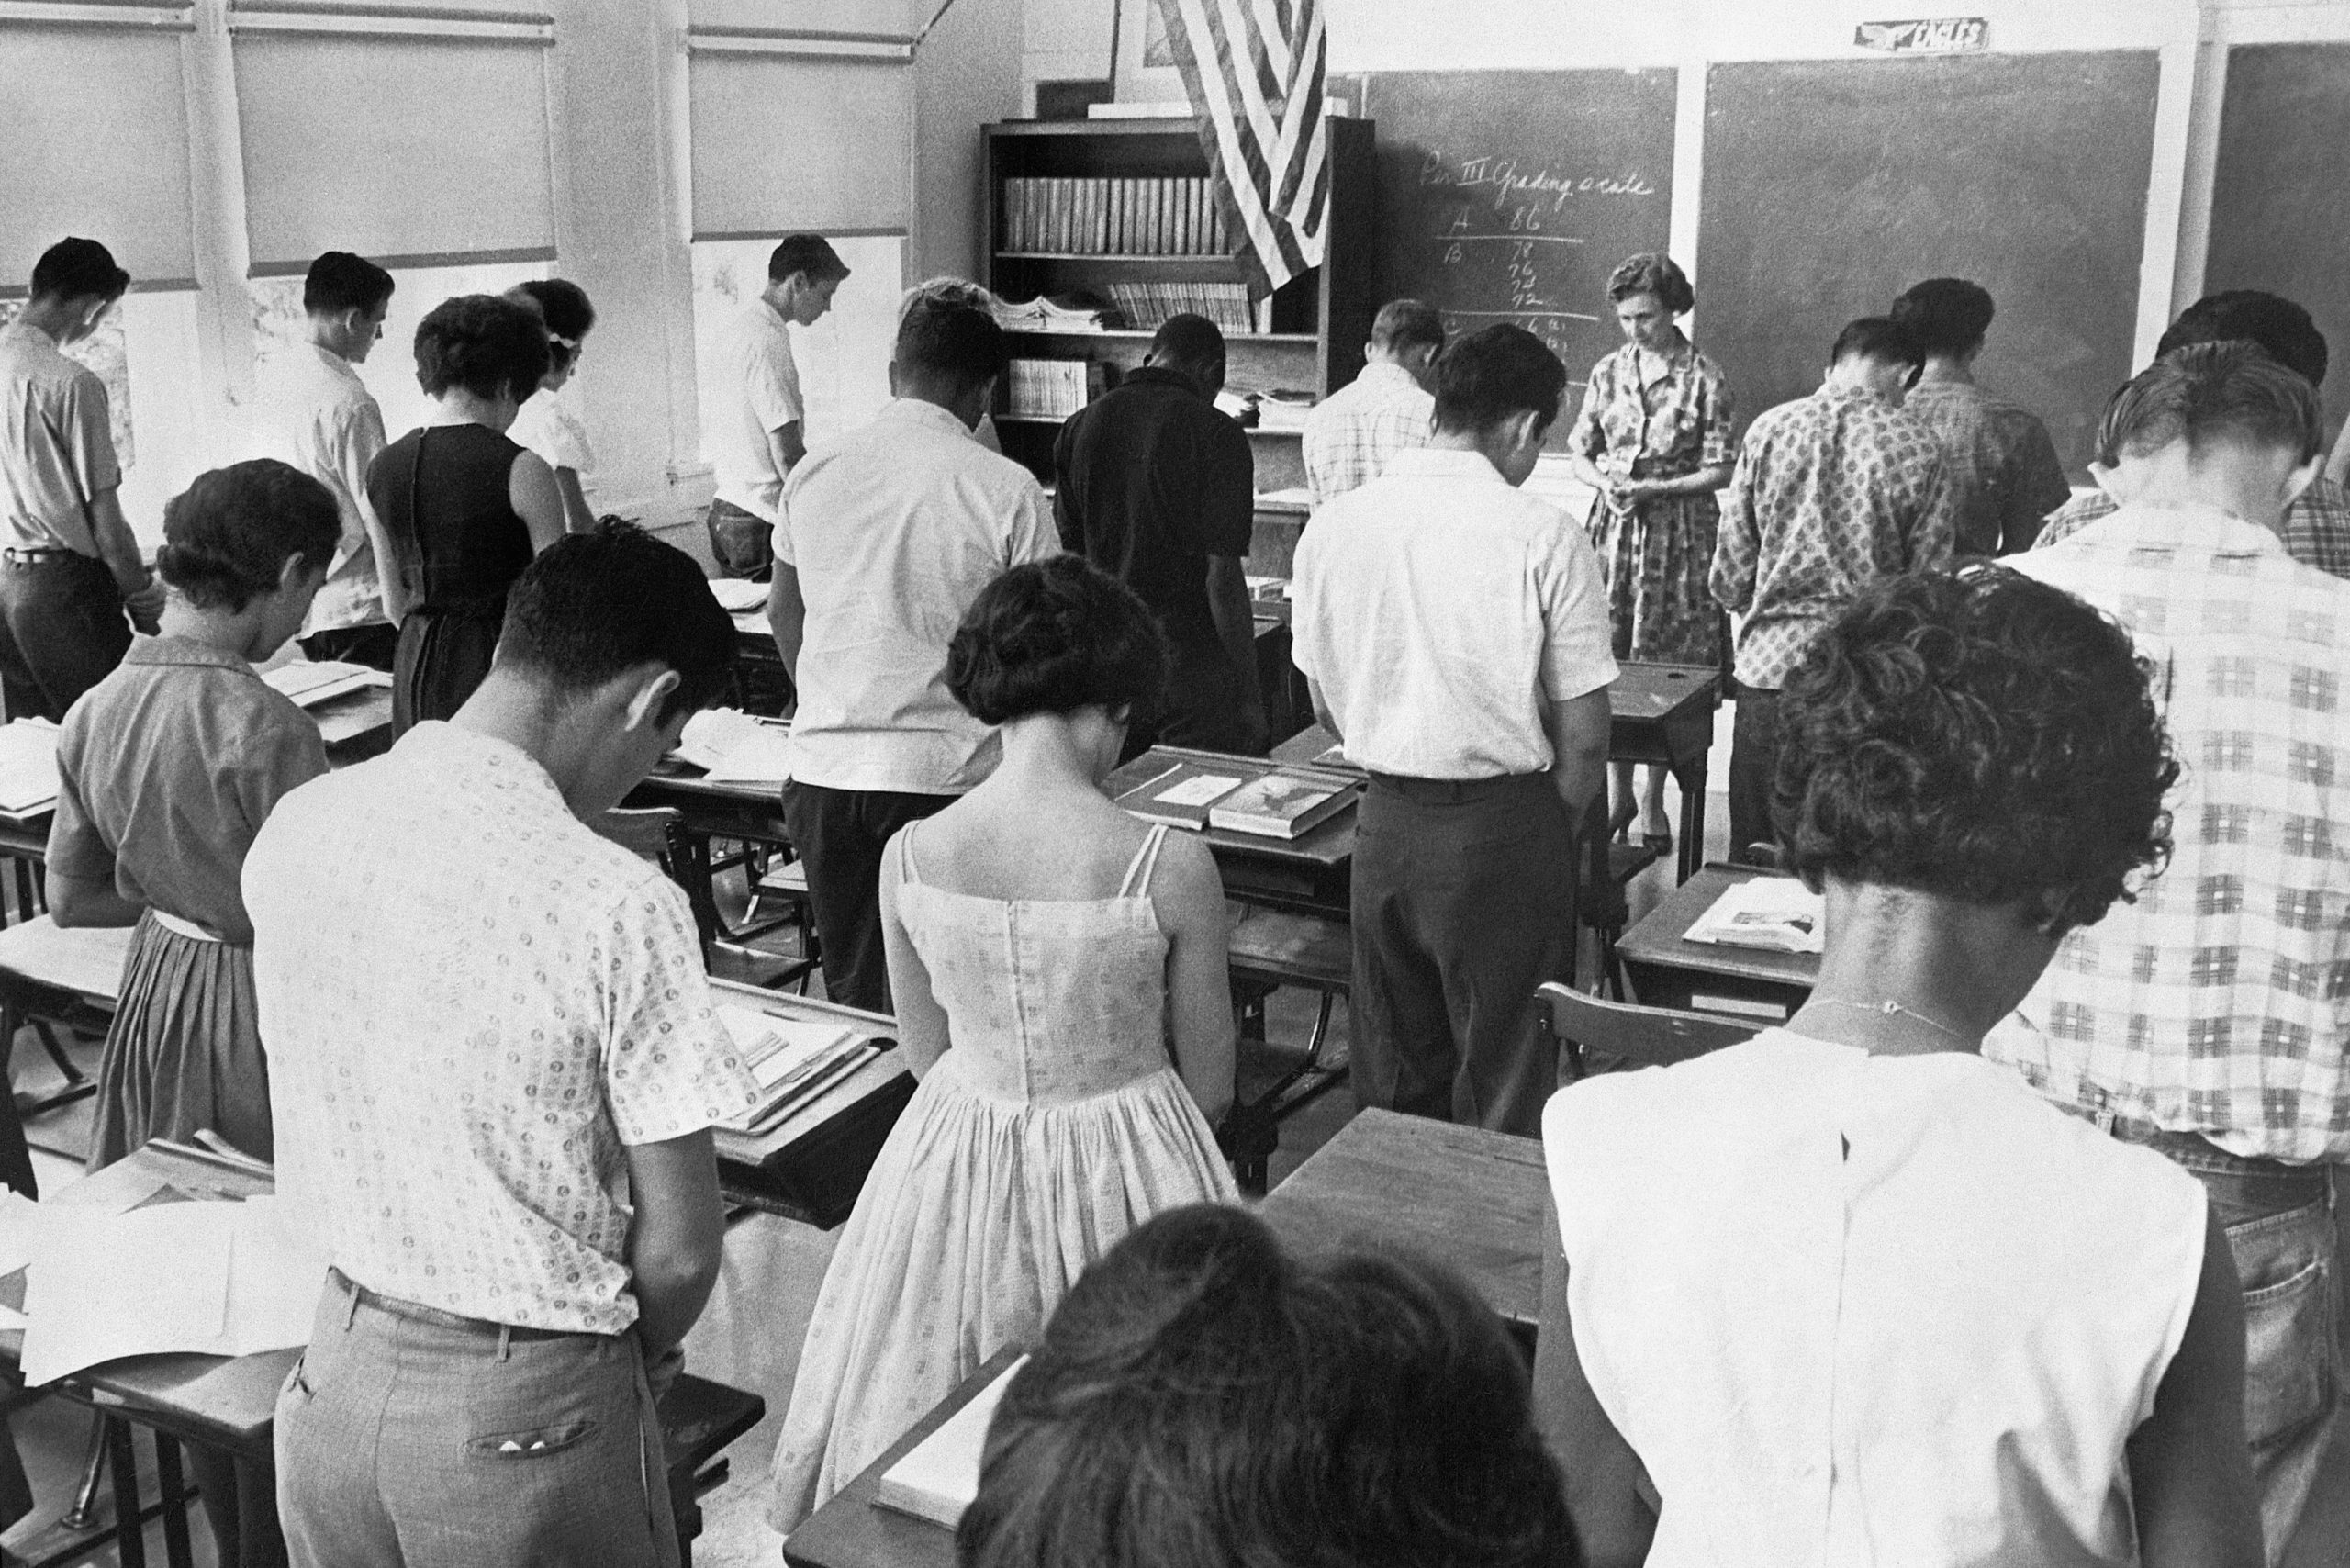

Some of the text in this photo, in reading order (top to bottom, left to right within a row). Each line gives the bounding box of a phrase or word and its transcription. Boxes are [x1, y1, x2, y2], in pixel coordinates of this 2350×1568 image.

[1911, 20, 1983, 50] EAGLES
[1493, 160, 1573, 211] Grading
[1578, 173, 1654, 196] scale
[1449, 202, 1541, 233] A 86
[1444, 241, 1462, 263] B
[1508, 261, 1533, 278] 76
[1512, 292, 1544, 309] 72
